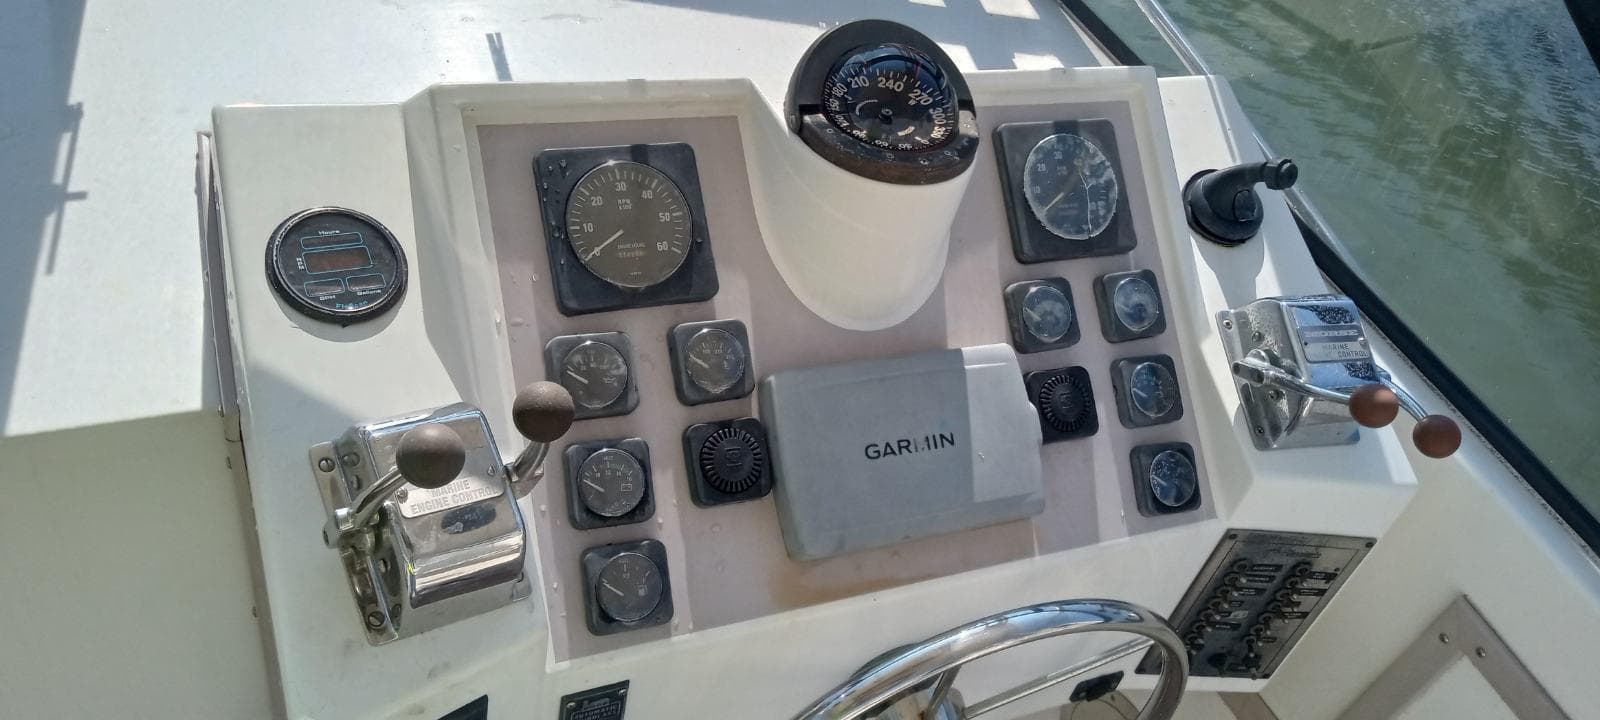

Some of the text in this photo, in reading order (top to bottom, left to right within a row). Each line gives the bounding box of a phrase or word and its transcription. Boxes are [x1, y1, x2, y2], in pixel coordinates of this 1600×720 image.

[847, 76, 870, 89] 210
[877, 77, 904, 92] 240
[831, 83, 848, 97] 180
[908, 89, 933, 106] 270
[929, 107, 946, 124] 300
[615, 181, 627, 193] 30
[590, 196, 603, 207] 20
[641, 190, 653, 201] 40
[658, 211, 671, 222] 50
[582, 222, 594, 233] 10
[656, 241, 669, 251] 60
[1337, 350, 1369, 358] CONTROL
[431, 479, 471, 498] MARINE
[410, 496, 451, 516] ENGINE
[451, 486, 498, 506] CONTROL
